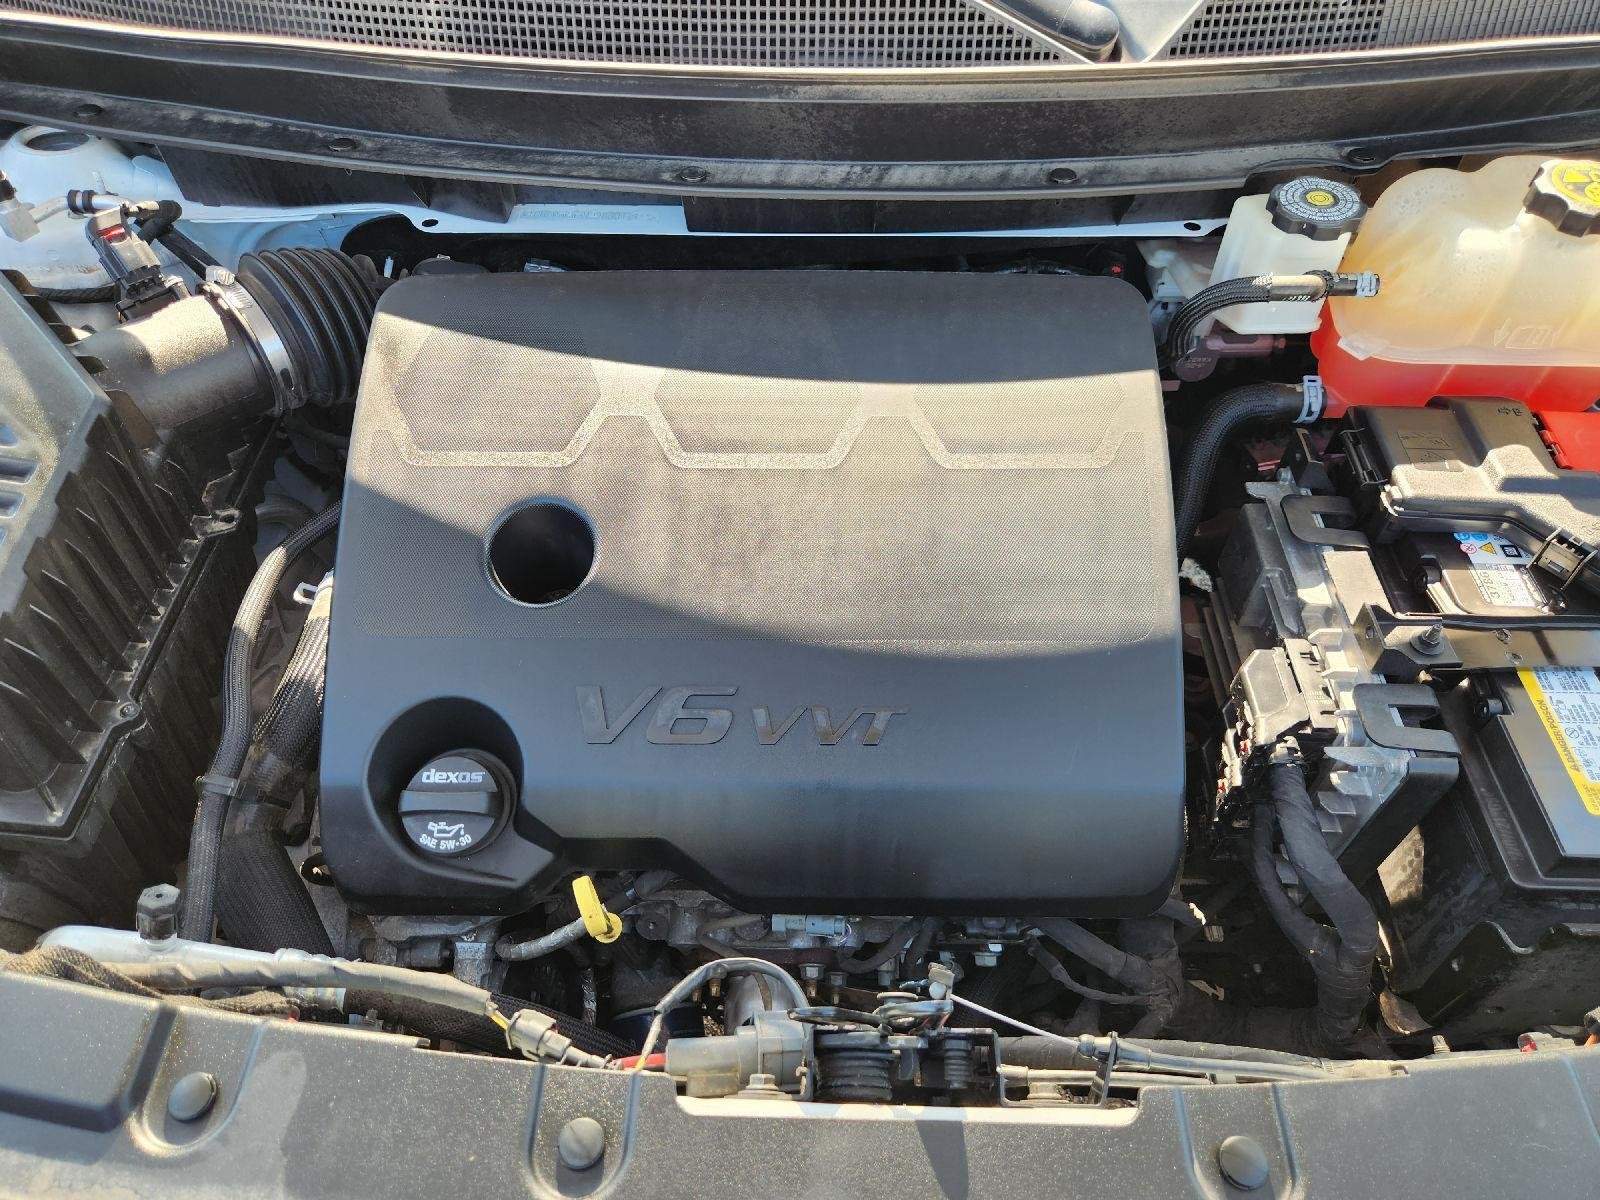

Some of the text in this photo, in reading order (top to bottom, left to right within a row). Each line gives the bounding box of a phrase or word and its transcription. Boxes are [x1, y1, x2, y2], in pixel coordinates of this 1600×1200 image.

[576, 686, 910, 745] V6 VVT
[421, 769, 483, 783] dexos
[419, 834, 472, 850] SAE 5W-30
